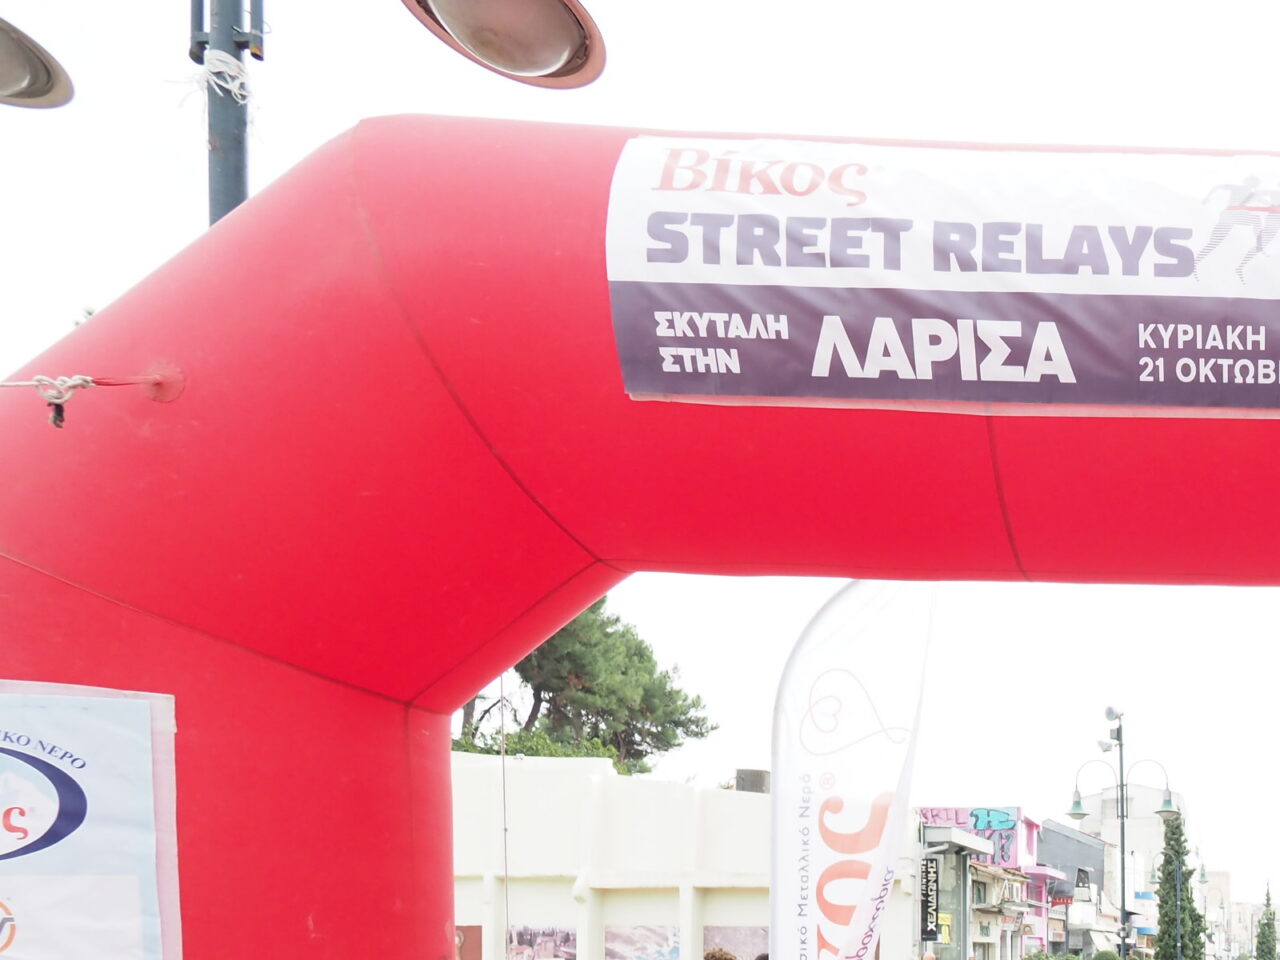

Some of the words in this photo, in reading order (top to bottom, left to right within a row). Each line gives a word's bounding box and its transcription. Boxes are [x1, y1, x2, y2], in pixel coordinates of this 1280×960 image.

[652, 147, 868, 207] Βίκος
[646, 211, 914, 271] STREET
[933, 220, 1196, 278] RELAYS
[653, 310, 790, 341] ΣΚΥΤΑΛΗ
[1137, 322, 1266, 352] ΚΥΡΙΑΚΗ
[658, 346, 742, 374] ΣΤΗΝ
[811, 314, 1077, 385] ΛΑΡΙΣΑ
[1138, 356, 1166, 384] 21
[34, 739, 87, 770] ΝΕΡΟ
[796, 825, 810, 918] Μεταλλικό
